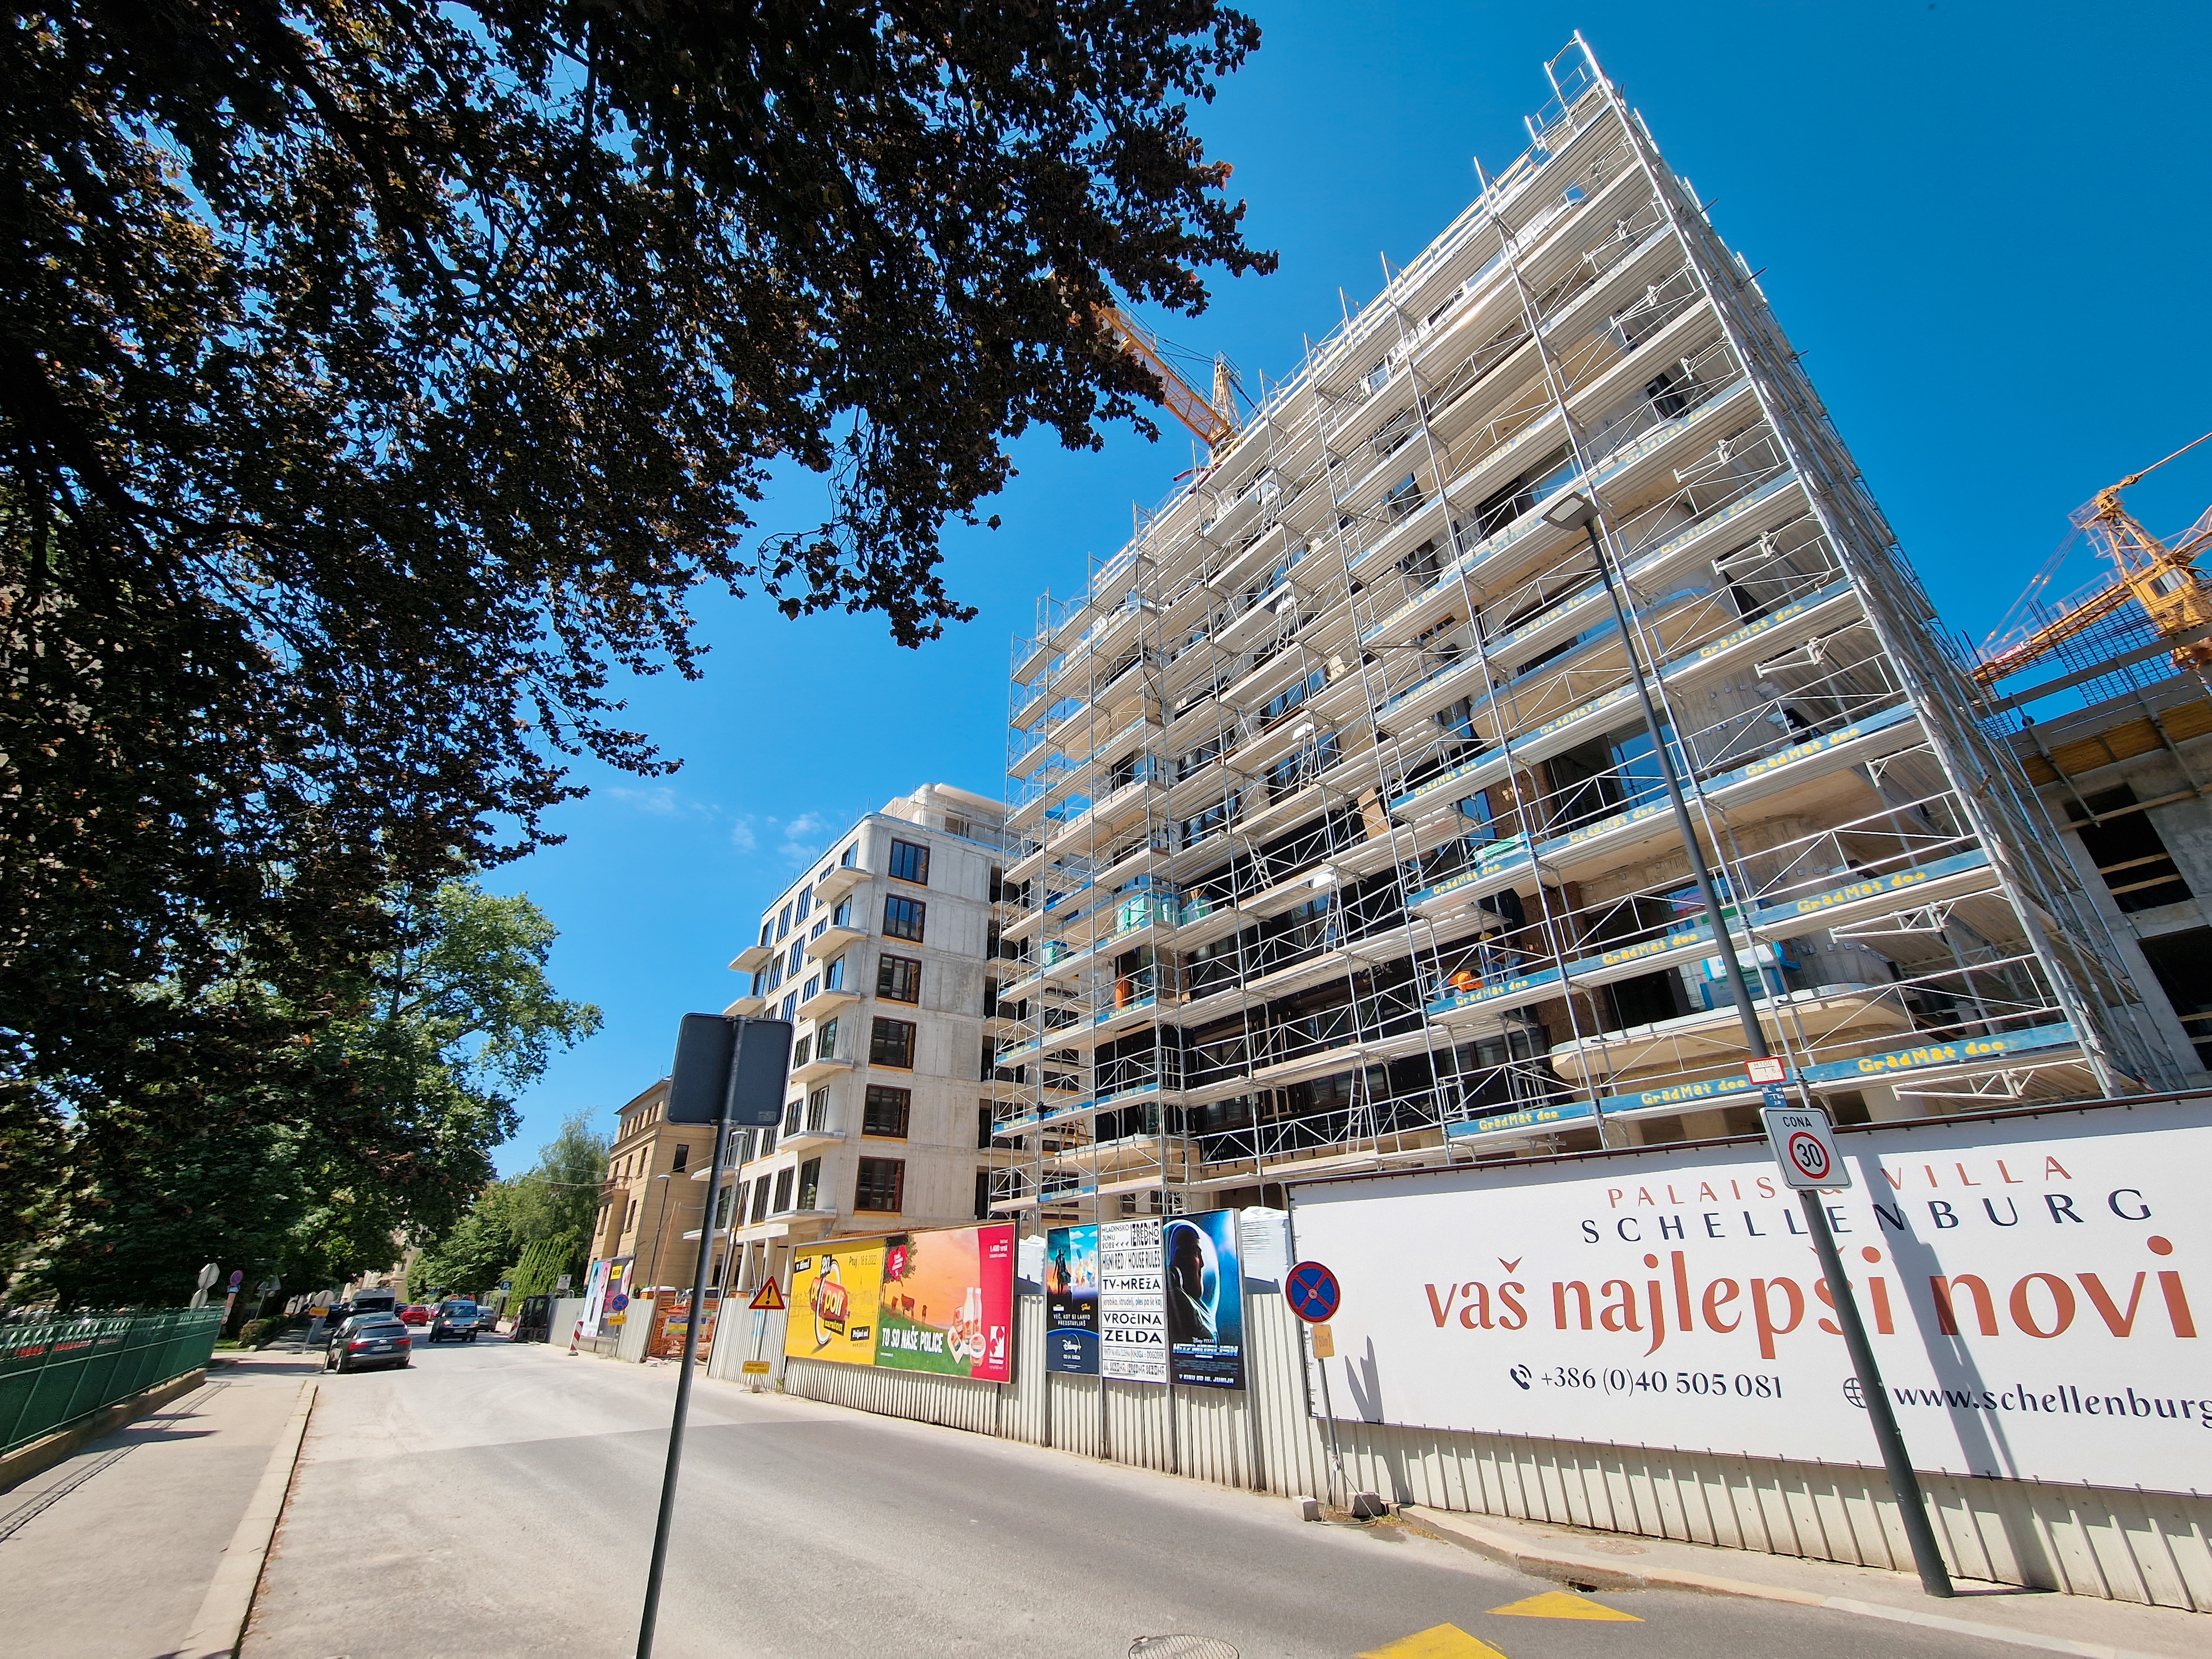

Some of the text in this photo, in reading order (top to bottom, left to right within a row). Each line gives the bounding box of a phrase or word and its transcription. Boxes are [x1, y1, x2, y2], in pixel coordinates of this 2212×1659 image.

[1783, 1115, 1813, 1129] CONA
[1796, 1141, 1824, 1169] 30
[1880, 1156, 2073, 1190] VILLA
[1608, 1177, 1776, 1208] PALAIS
[1102, 1224, 1129, 1233] MLADINSKO
[1582, 1188, 2151, 1244] SCHELLENBURG
[849, 1255, 858, 1269] Ptuj
[1115, 1253, 1124, 1270] RED
[1128, 1251, 1145, 1269] HOUSE
[1146, 1250, 1161, 1269] RULES
[823, 1289, 846, 1317] poli
[1425, 1235, 2198, 1360] vaš najlepši novi
[824, 1319, 843, 1333] maraton
[881, 1325, 944, 1354] TO SO NAŠE POLICE
[1104, 1329, 1163, 1344] ZELDA
[1147, 1350, 1165, 1360] DOGODEK
[1541, 1366, 1782, 1399] +386 (0)40 505 081
